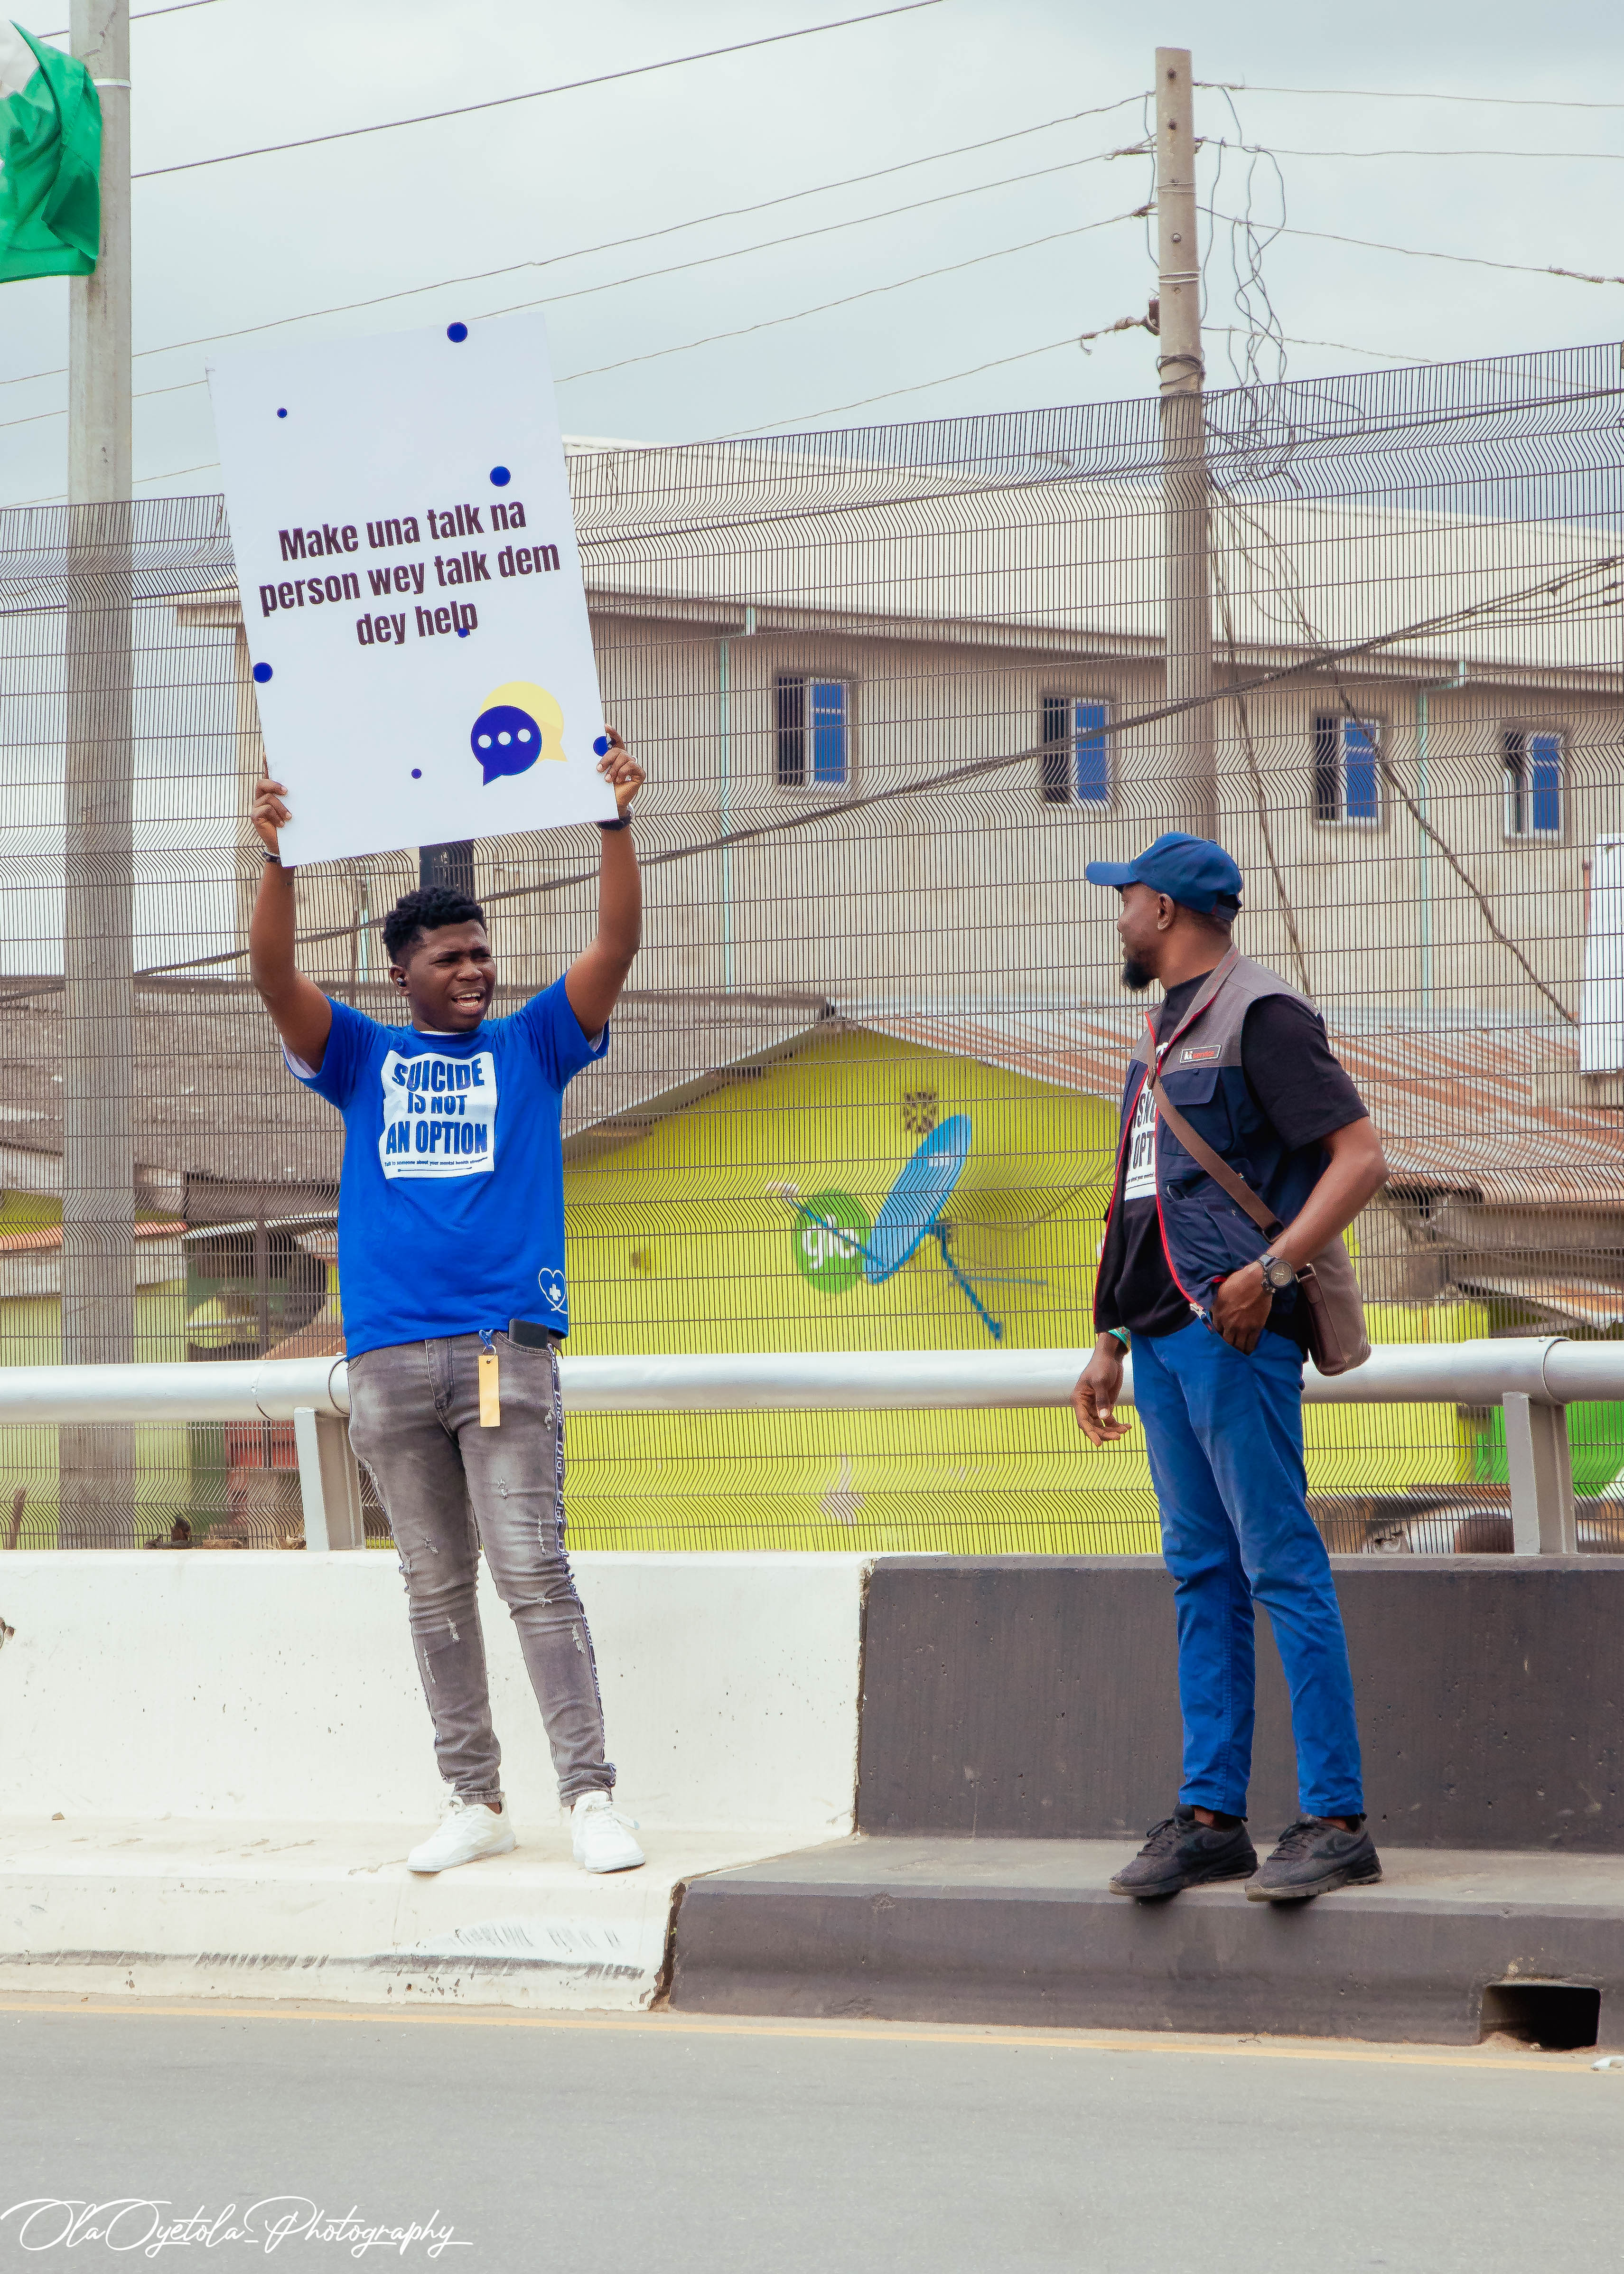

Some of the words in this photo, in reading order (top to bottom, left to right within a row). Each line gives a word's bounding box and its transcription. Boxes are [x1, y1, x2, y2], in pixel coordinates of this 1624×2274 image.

[278, 521, 359, 561] Make
[366, 516, 421, 549] una
[426, 504, 485, 540] talk
[489, 501, 527, 532] na
[259, 572, 361, 618] person
[367, 562, 424, 596] wey
[433, 550, 492, 587] talk
[497, 544, 560, 578] dem
[356, 612, 406, 646] dey
[414, 600, 478, 637] help
[392, 1057, 485, 1092] SUICIDE
[407, 1091, 426, 1114] IS
[431, 1095, 467, 1115] NOT
[386, 1121, 411, 1155] AN
[415, 1120, 487, 1155] OPTION
